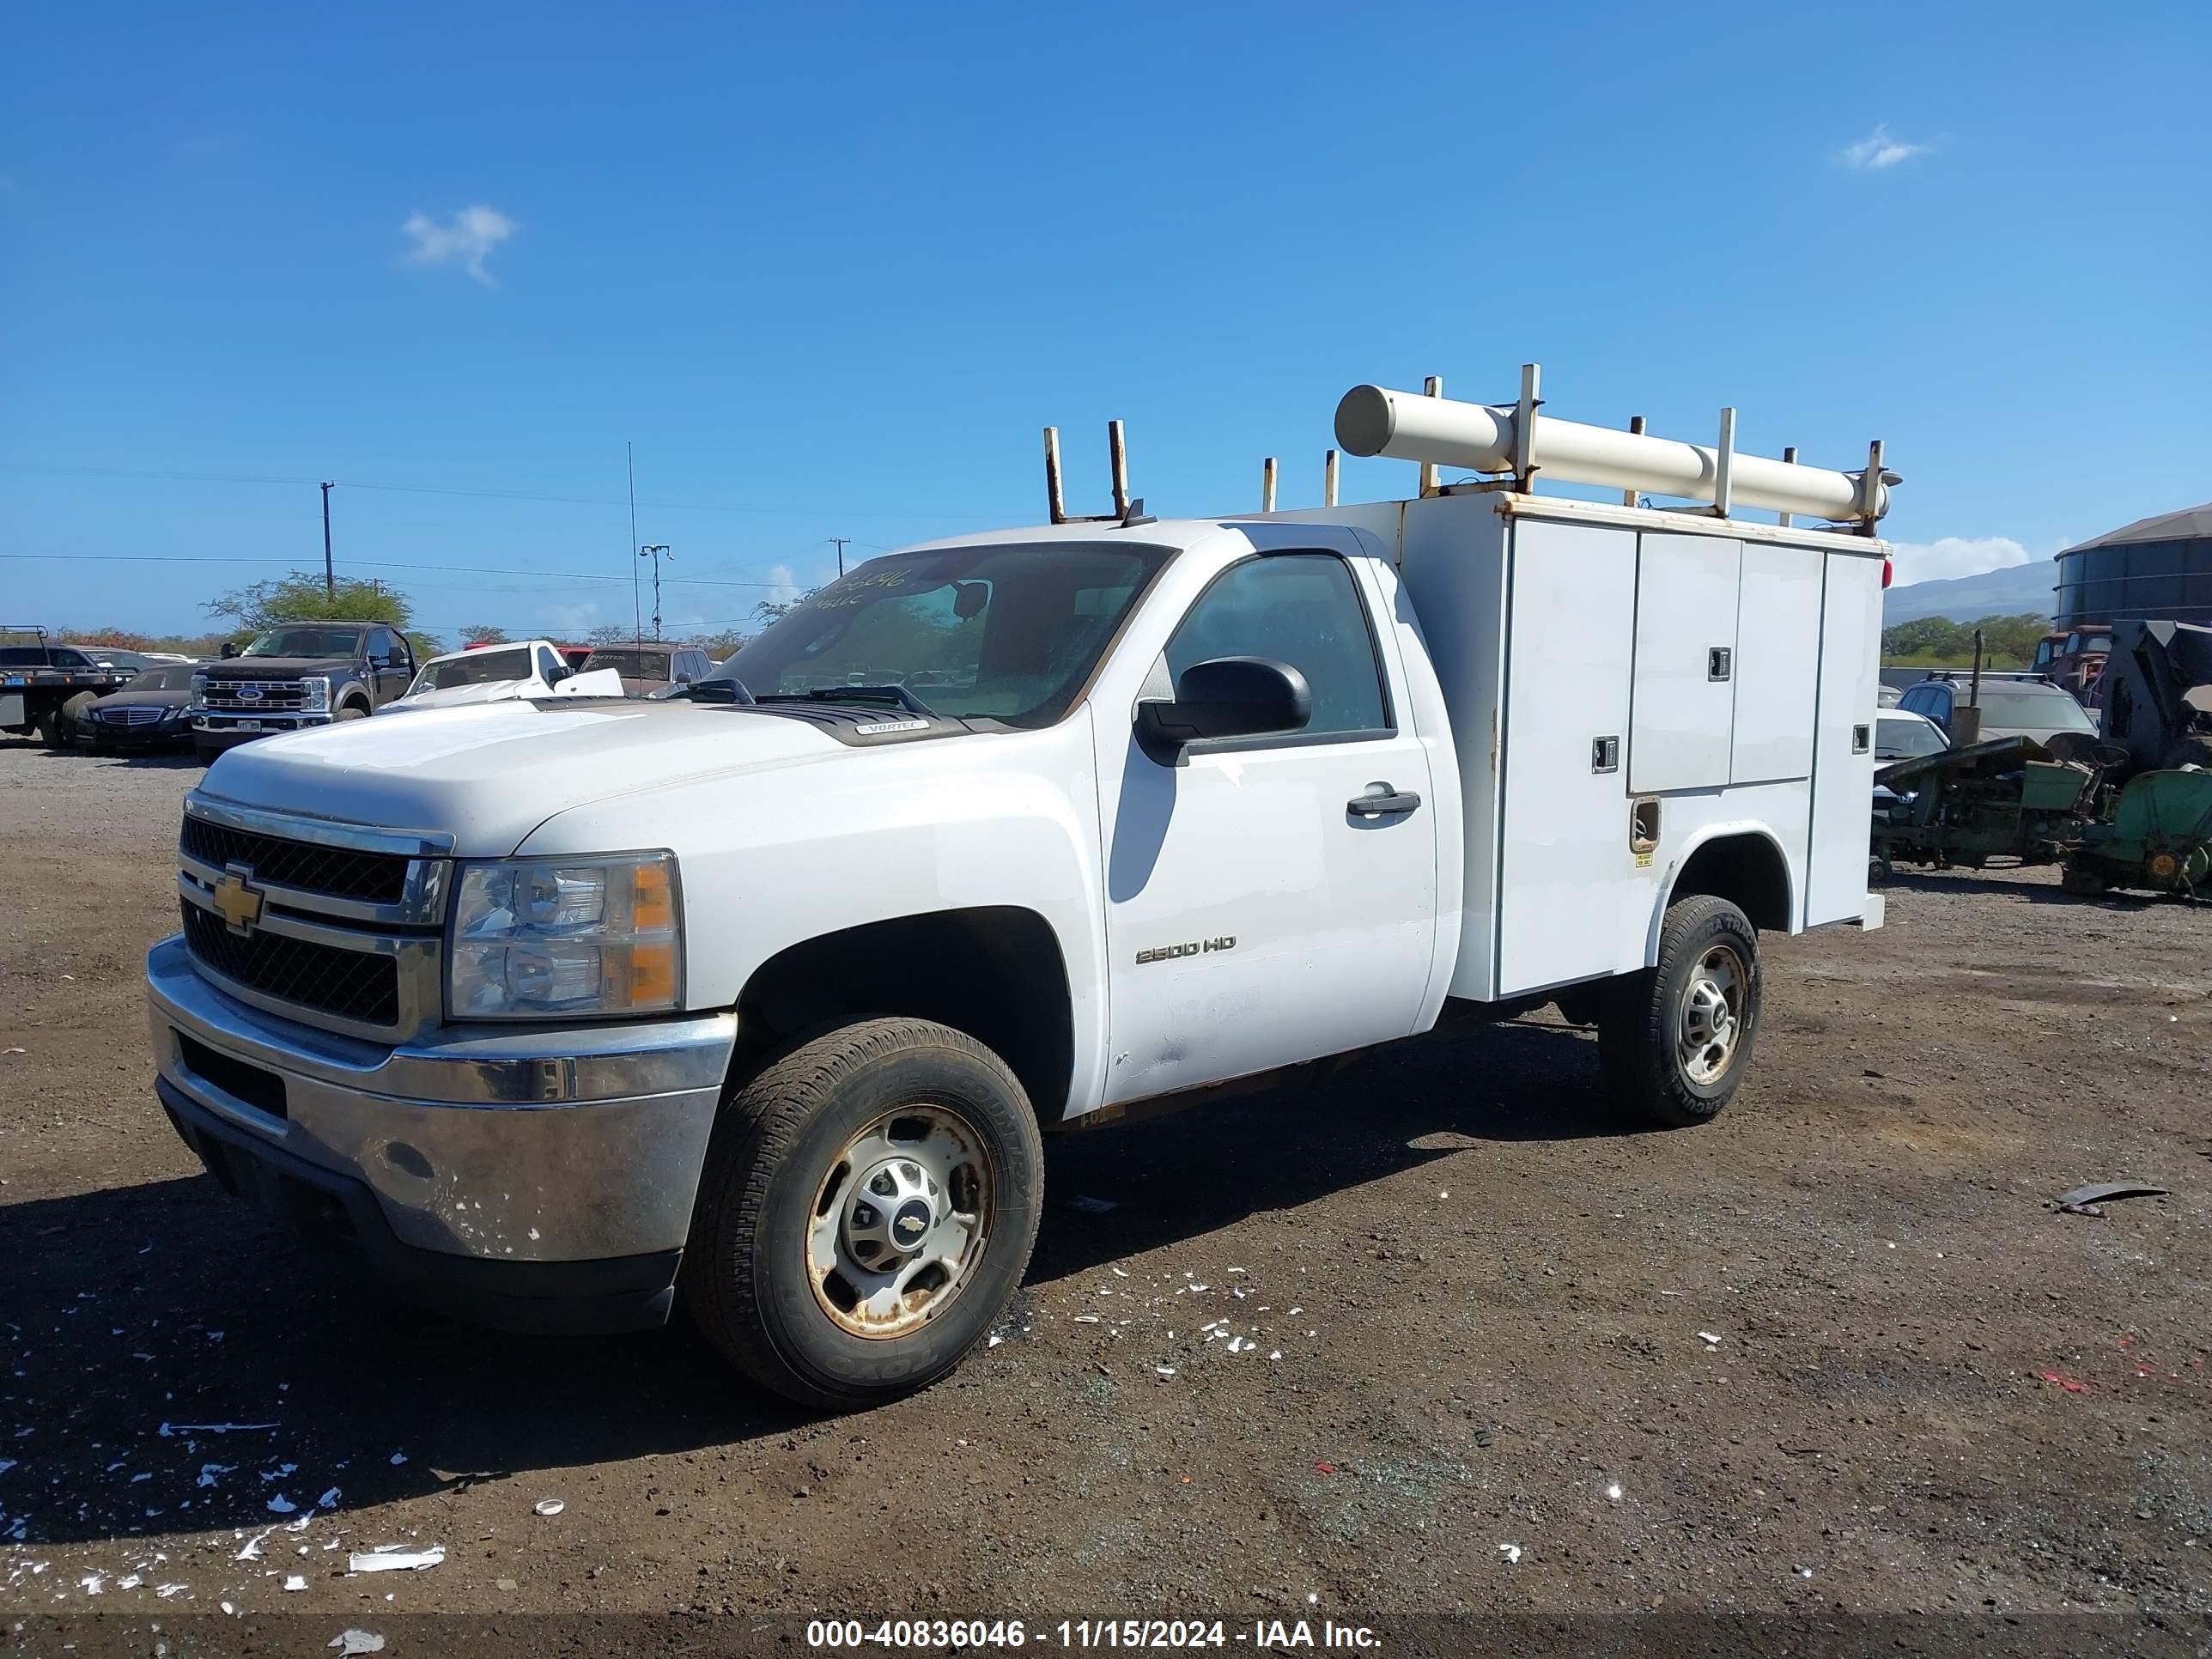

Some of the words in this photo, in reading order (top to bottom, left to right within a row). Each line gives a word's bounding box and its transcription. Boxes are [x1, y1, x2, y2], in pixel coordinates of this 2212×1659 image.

[868, 721, 918, 732] VORTEC
[1135, 940, 1200, 965] 2500
[1203, 934, 1237, 953] HD
